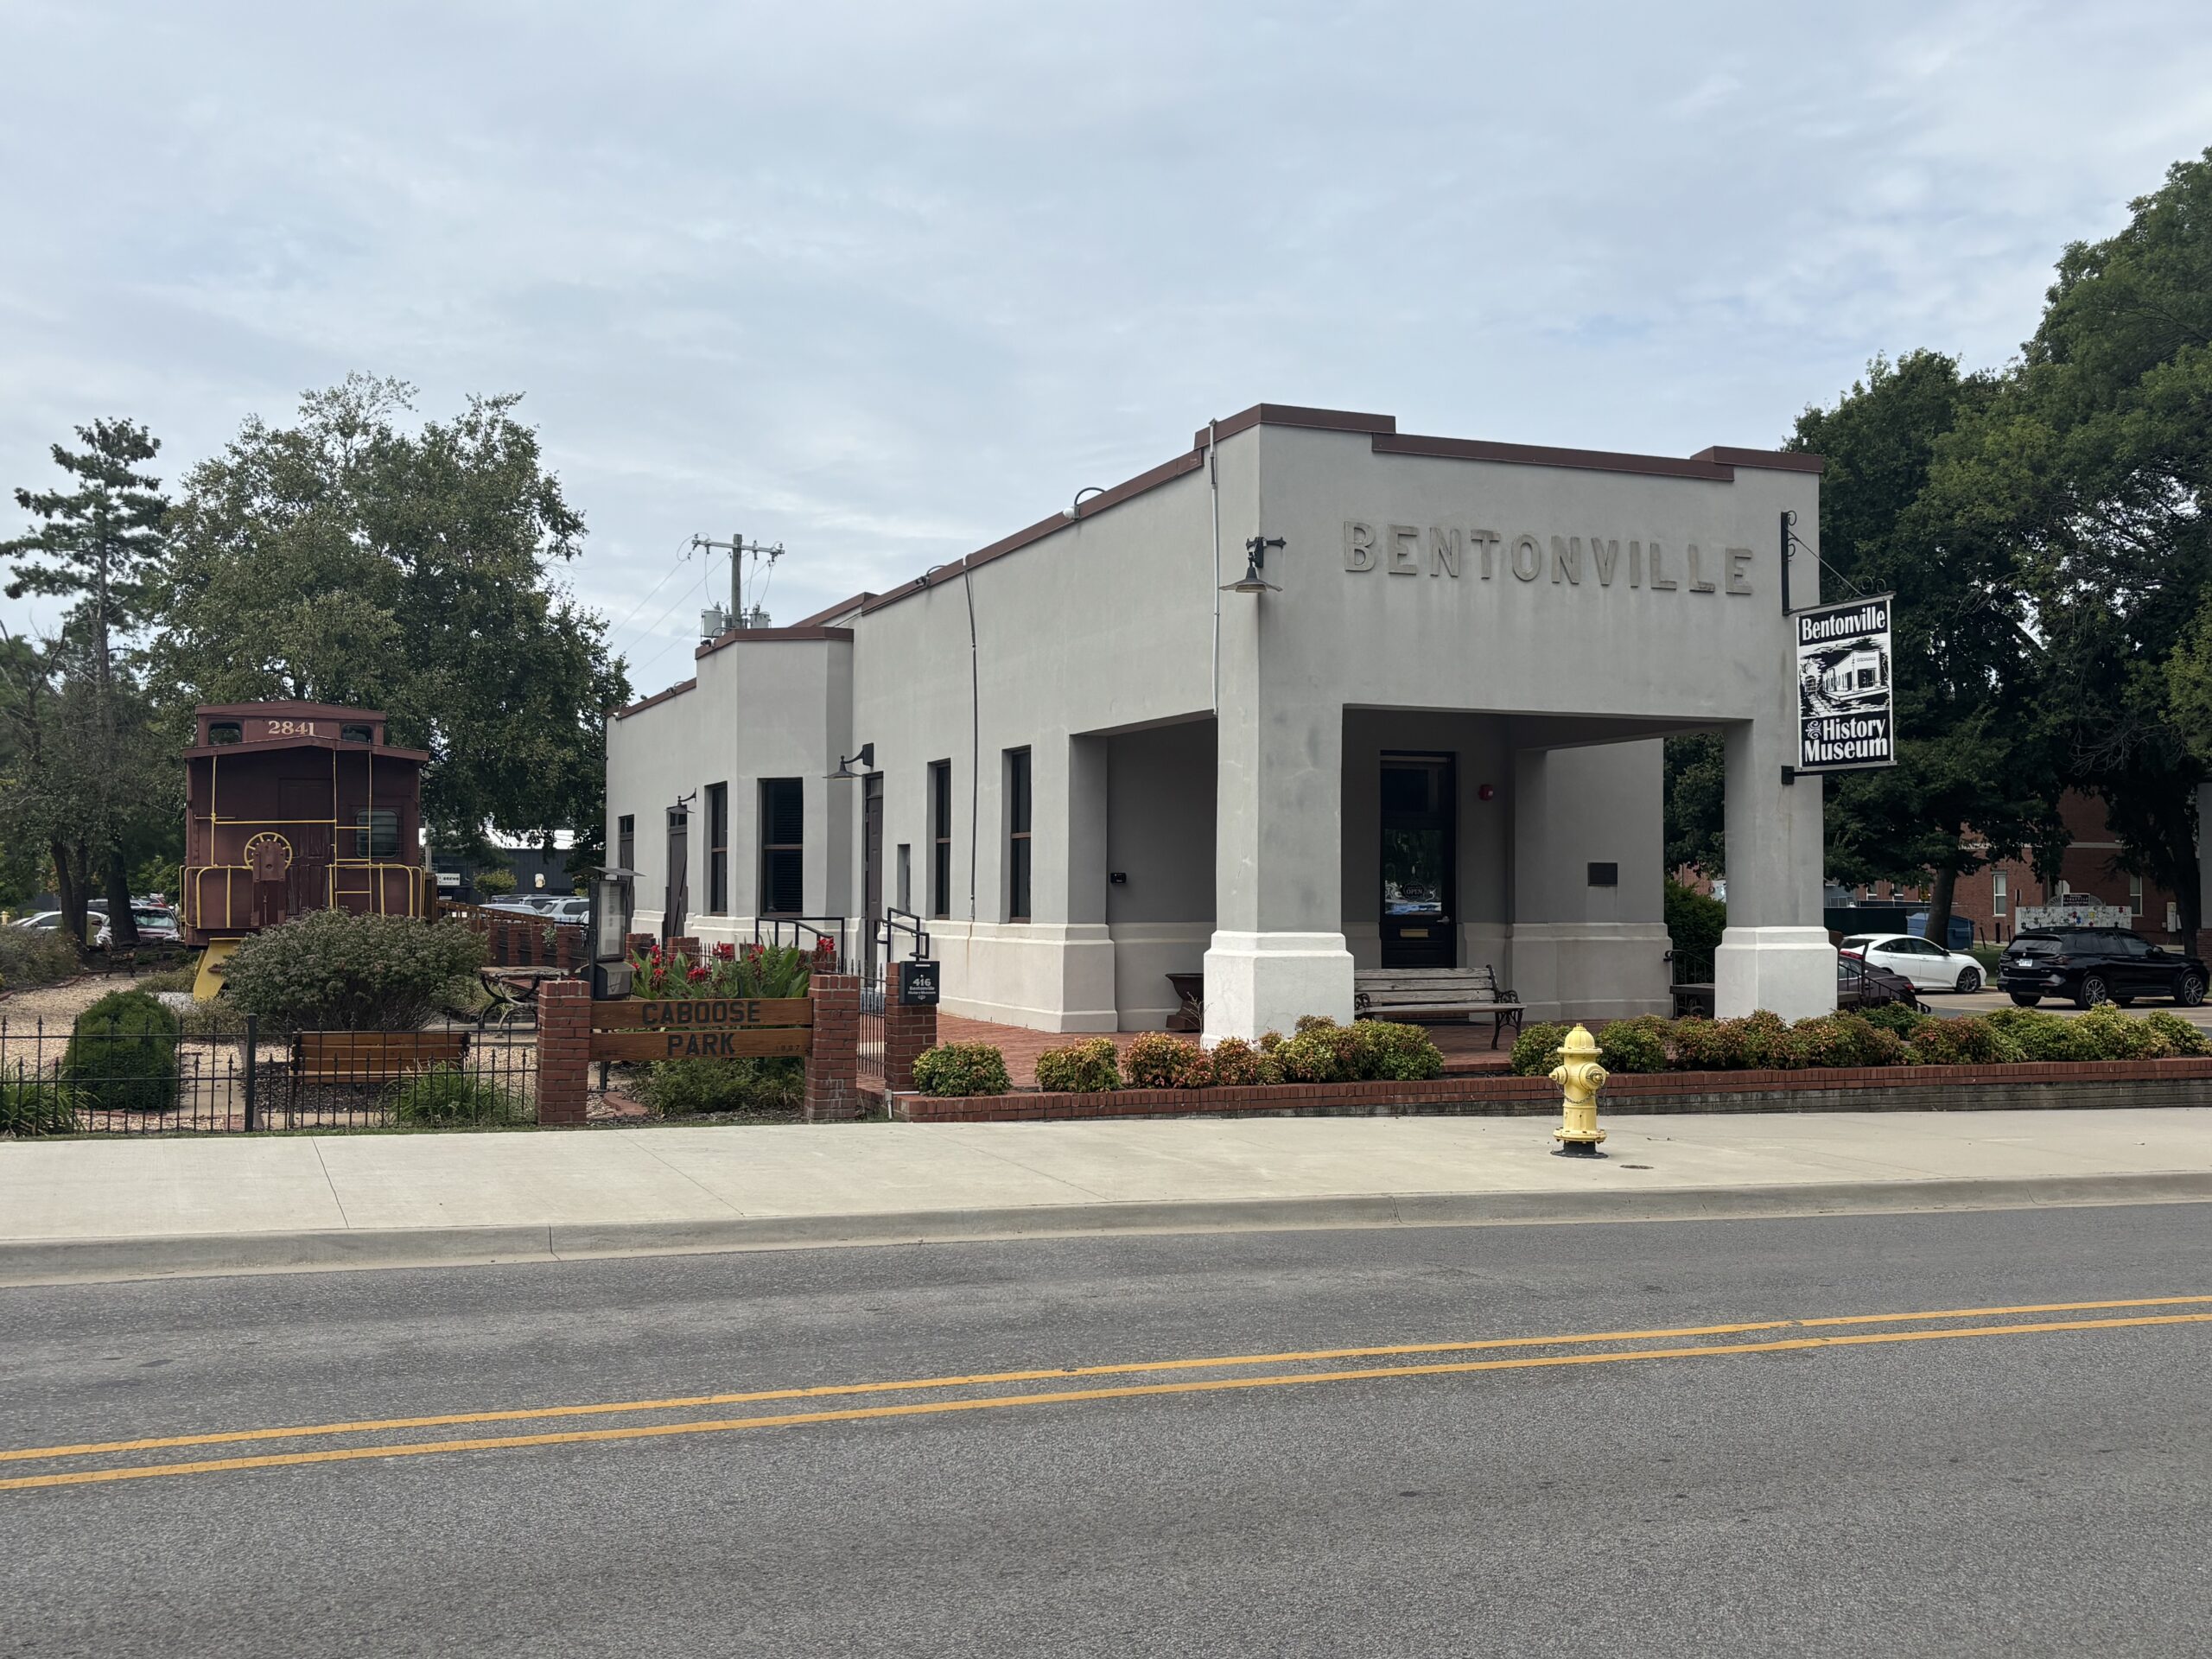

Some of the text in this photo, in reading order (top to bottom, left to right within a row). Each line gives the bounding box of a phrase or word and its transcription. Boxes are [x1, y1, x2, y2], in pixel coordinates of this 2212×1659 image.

[1344, 521, 1753, 595] BENTONVILLE
[1802, 607, 1885, 641] Bentonville
[268, 721, 315, 735] 2841
[1823, 718, 1886, 741] History
[1804, 737, 1888, 762] Museum
[912, 978, 931, 987] 416
[642, 1001, 761, 1026] CABOOSE
[667, 1033, 735, 1057] PARK
